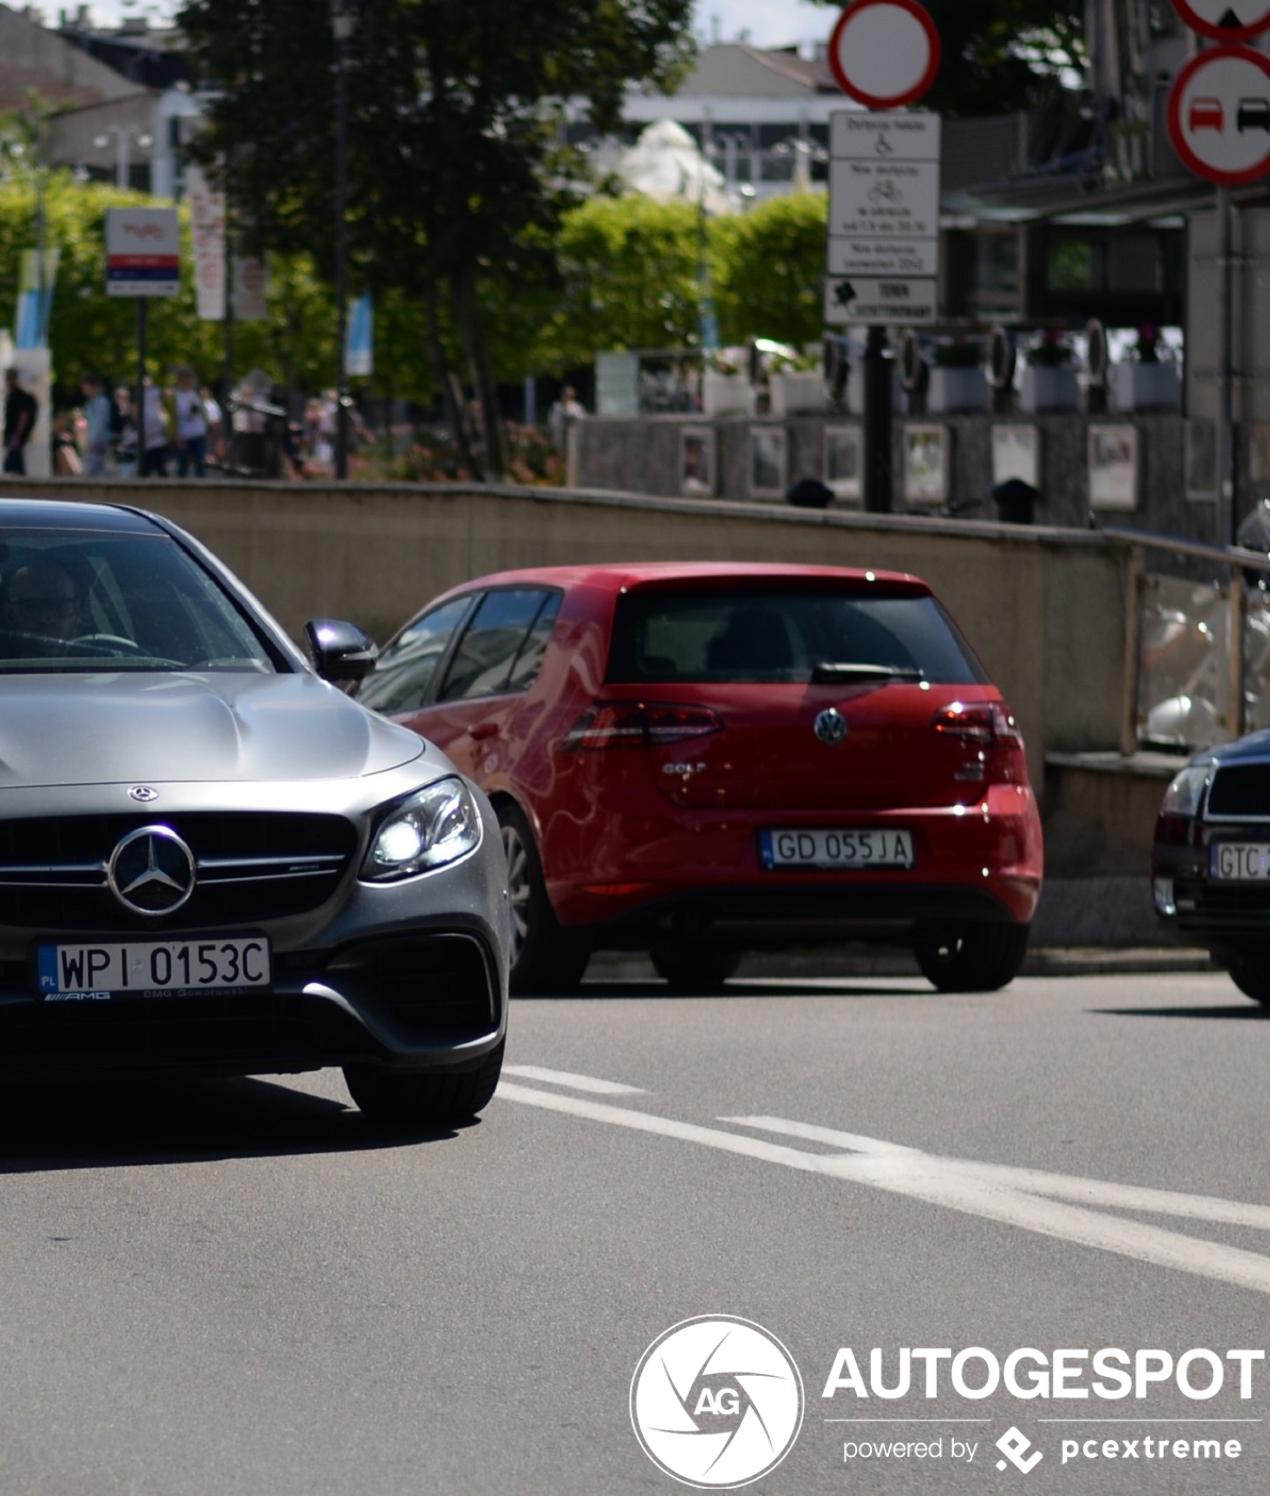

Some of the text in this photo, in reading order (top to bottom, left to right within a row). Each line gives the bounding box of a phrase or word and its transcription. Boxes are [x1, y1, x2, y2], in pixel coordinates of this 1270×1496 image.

[662, 763, 706, 773] GOLF
[777, 833, 909, 861] GD 055JA
[1220, 846, 1259, 878] GTC
[60, 942, 264, 988] WPI 0153C
[41, 975, 56, 987] PL
[64, 991, 111, 1001] AMG
[143, 986, 248, 998] BMG Goworowski
